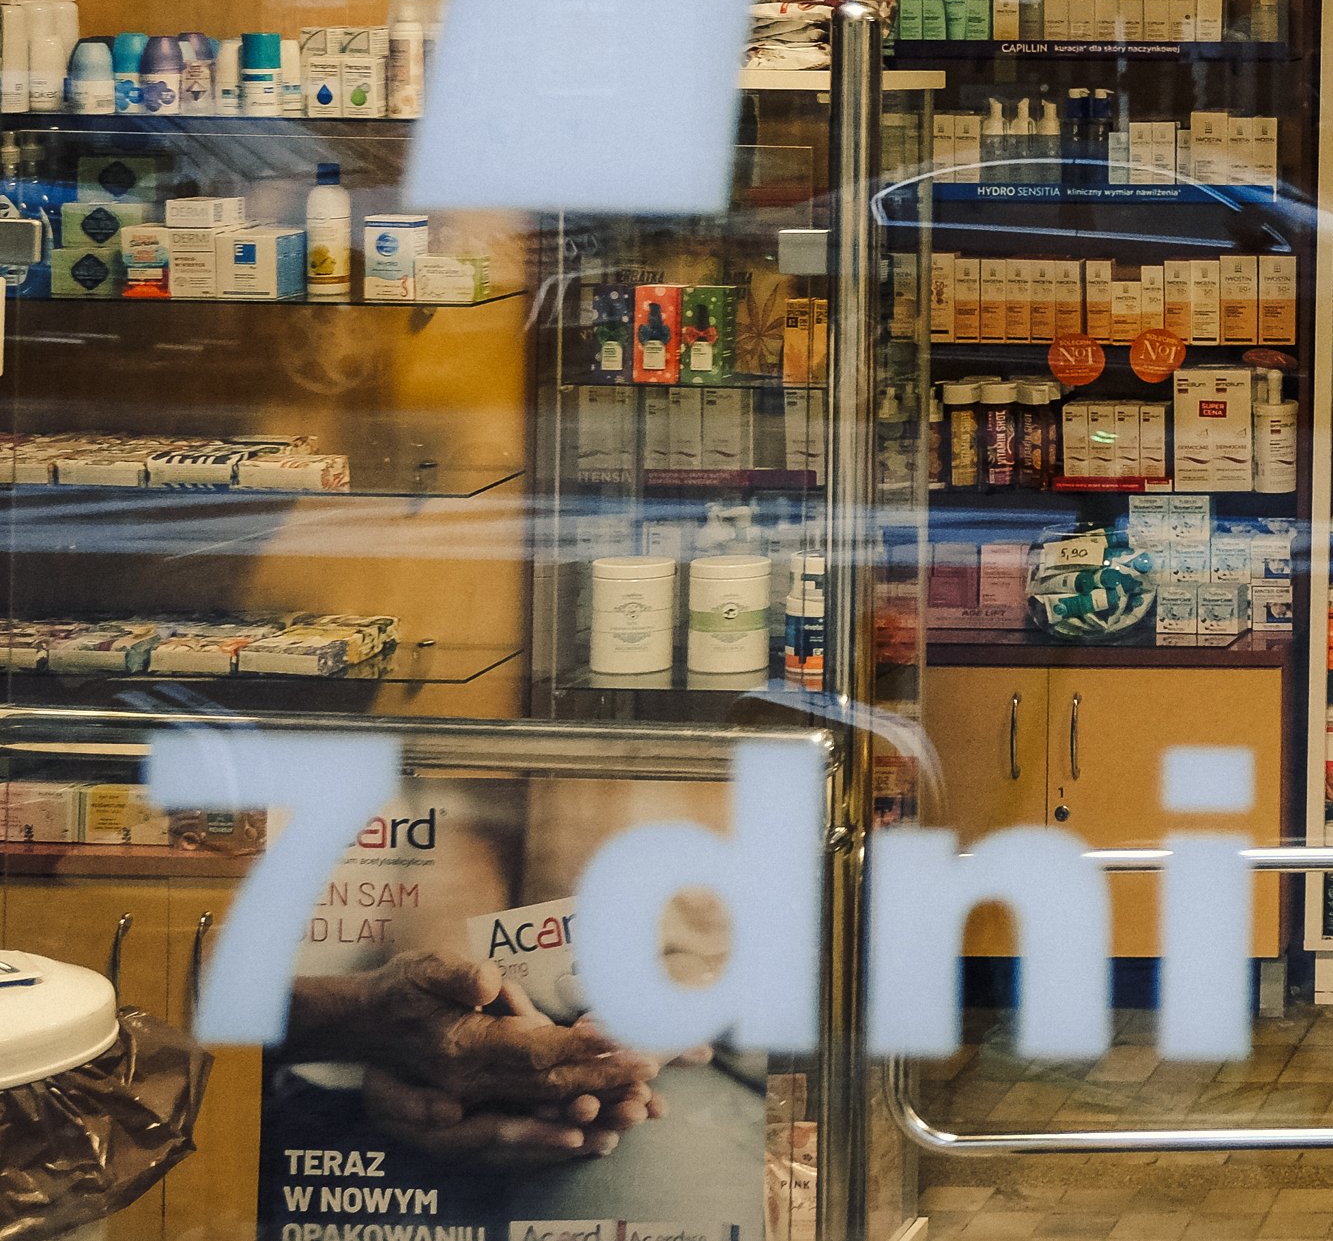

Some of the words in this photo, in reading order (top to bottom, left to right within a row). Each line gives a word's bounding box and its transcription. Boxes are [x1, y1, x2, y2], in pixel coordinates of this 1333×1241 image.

[1001, 44, 1047, 53] CAPILLIN
[1104, 45, 1126, 54] skóry
[1128, 46, 1180, 54] naczynkowej
[977, 187, 1015, 196] HYDRO
[1017, 187, 1060, 196] SENSITIA
[1067, 189, 1102, 197] kliniczny
[236, 245, 243, 255] E
[1060, 547, 1088, 560] 5,90
[357, 808, 436, 849] ard
[360, 857, 435, 866] acetylsalicylicum
[148, 728, 402, 1045] 7
[578, 732, 1258, 1070] dni
[359, 882, 419, 908] SAM
[488, 912, 576, 958] Acar
[285, 1149, 386, 1178] TERAZ
[780, 1180, 810, 1189] PNK
[284, 1188, 312, 1214] W
[319, 1188, 439, 1216] NOWYM
